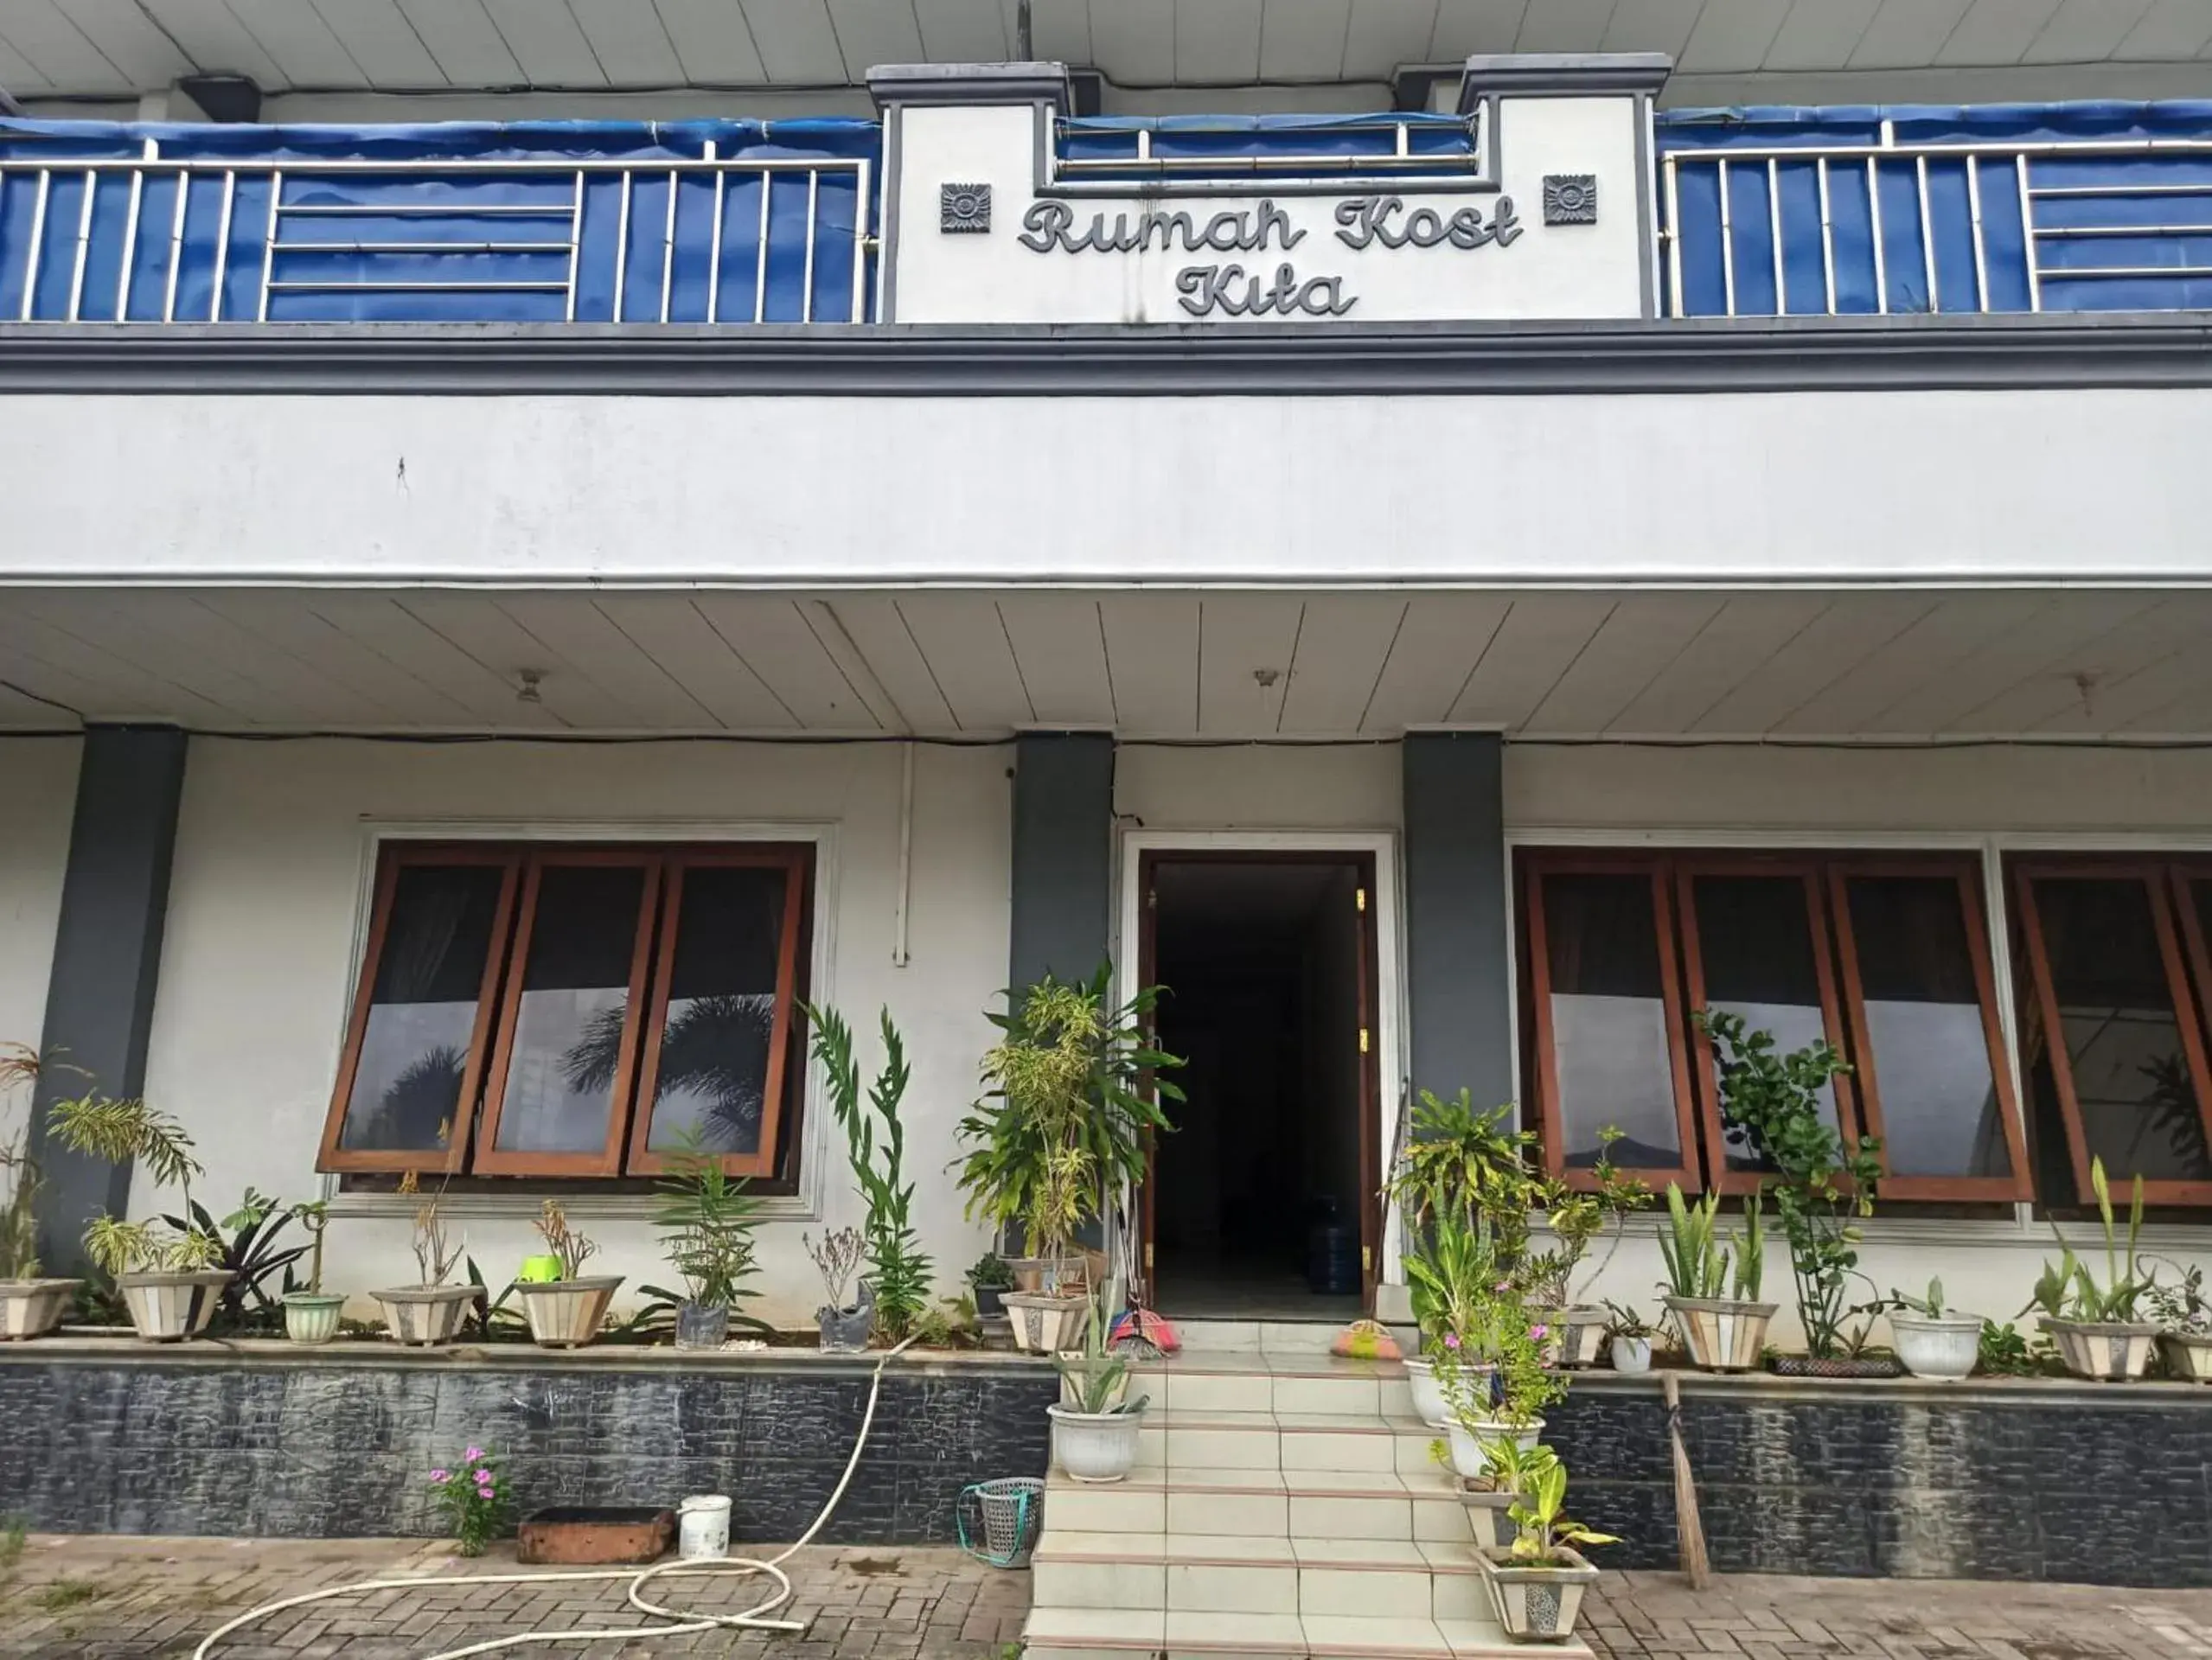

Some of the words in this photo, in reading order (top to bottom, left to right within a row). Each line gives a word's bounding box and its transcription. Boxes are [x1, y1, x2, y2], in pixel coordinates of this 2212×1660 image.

[1017, 197, 1307, 253] Rumah
[1333, 195, 1525, 250] Kost
[1176, 263, 1359, 316] Kita
